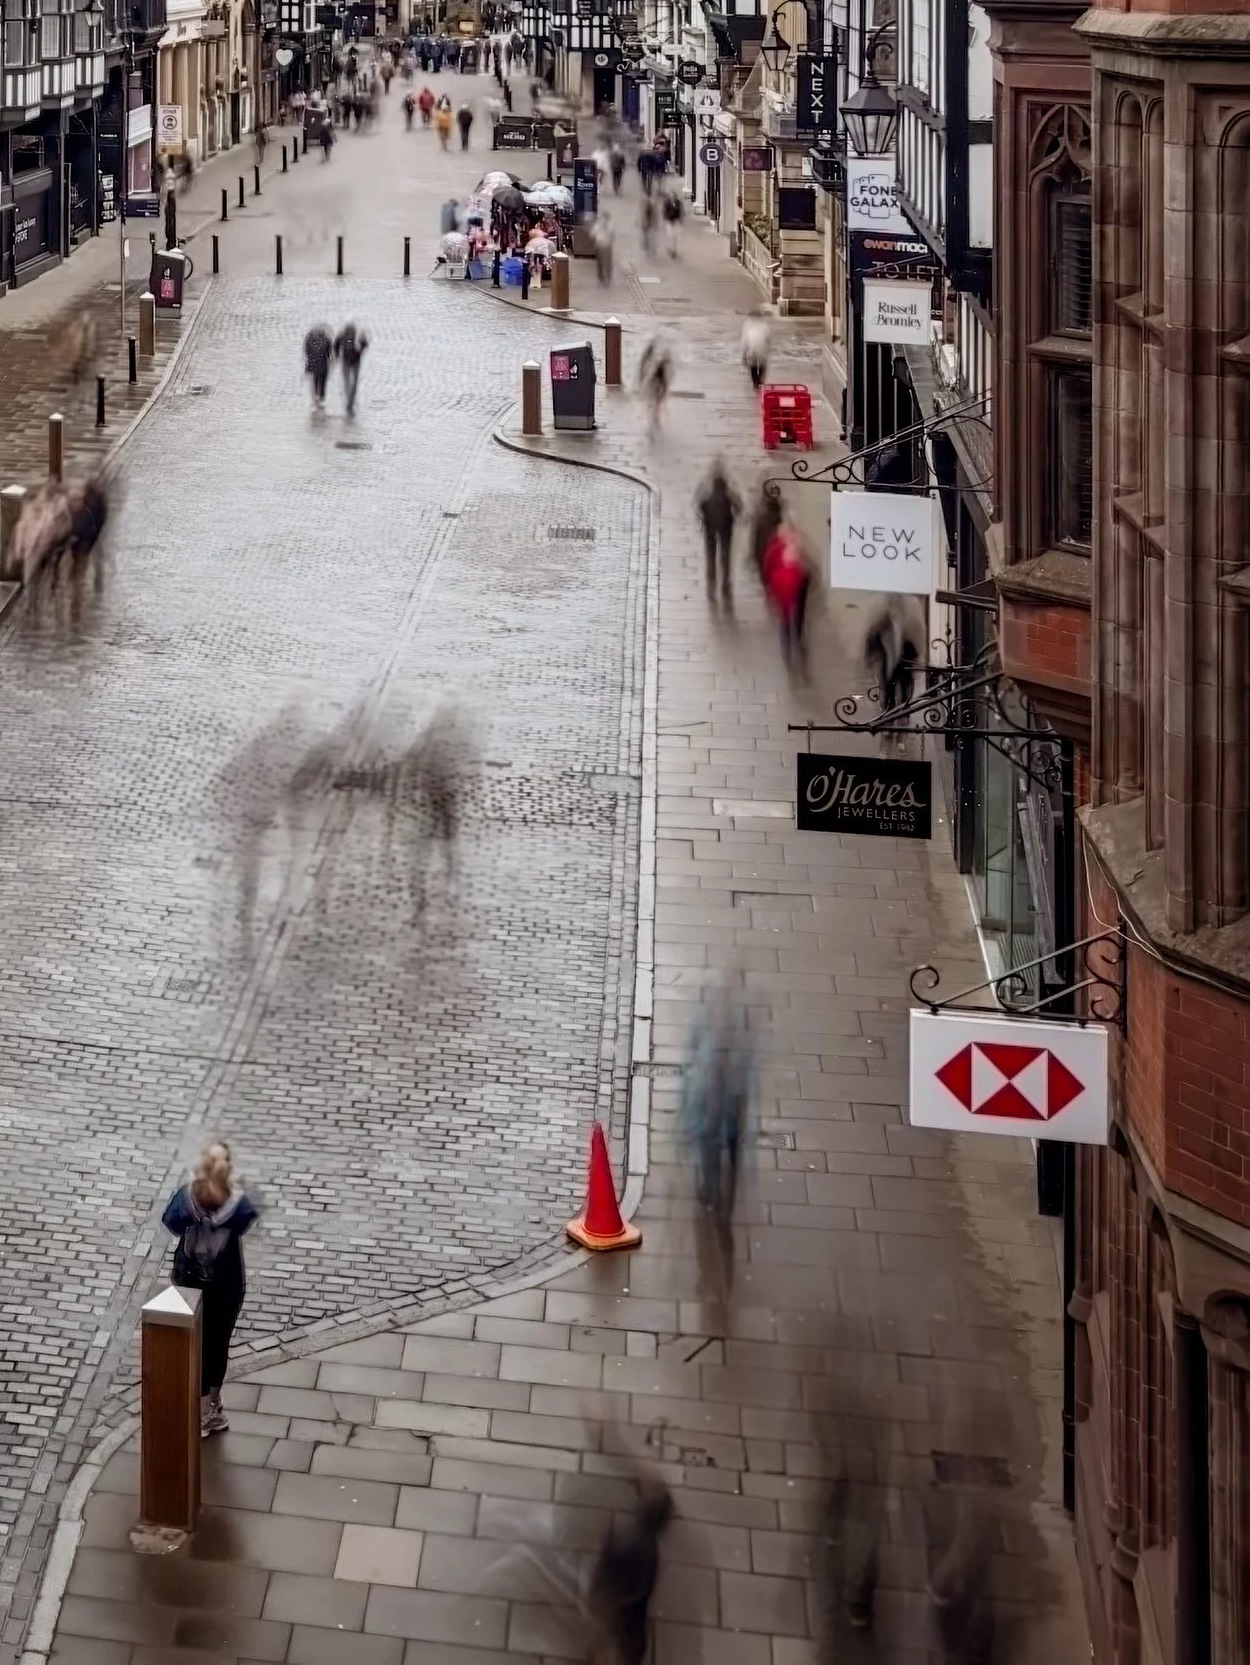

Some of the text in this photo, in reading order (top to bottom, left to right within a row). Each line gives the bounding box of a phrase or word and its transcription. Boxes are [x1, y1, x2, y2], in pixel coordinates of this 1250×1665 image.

[810, 62, 825, 124] NEXT
[706, 148, 719, 161] B
[860, 185, 898, 196] FONE
[850, 196, 899, 208] GALAX
[872, 260, 940, 283] TO LET
[878, 301, 918, 316] Russell
[872, 314, 923, 331] Bromley
[848, 525, 916, 543] NEW
[842, 542, 922, 562] LOOK
[806, 765, 927, 813] O'Hares
[837, 806, 916, 822] JEWELLERS
